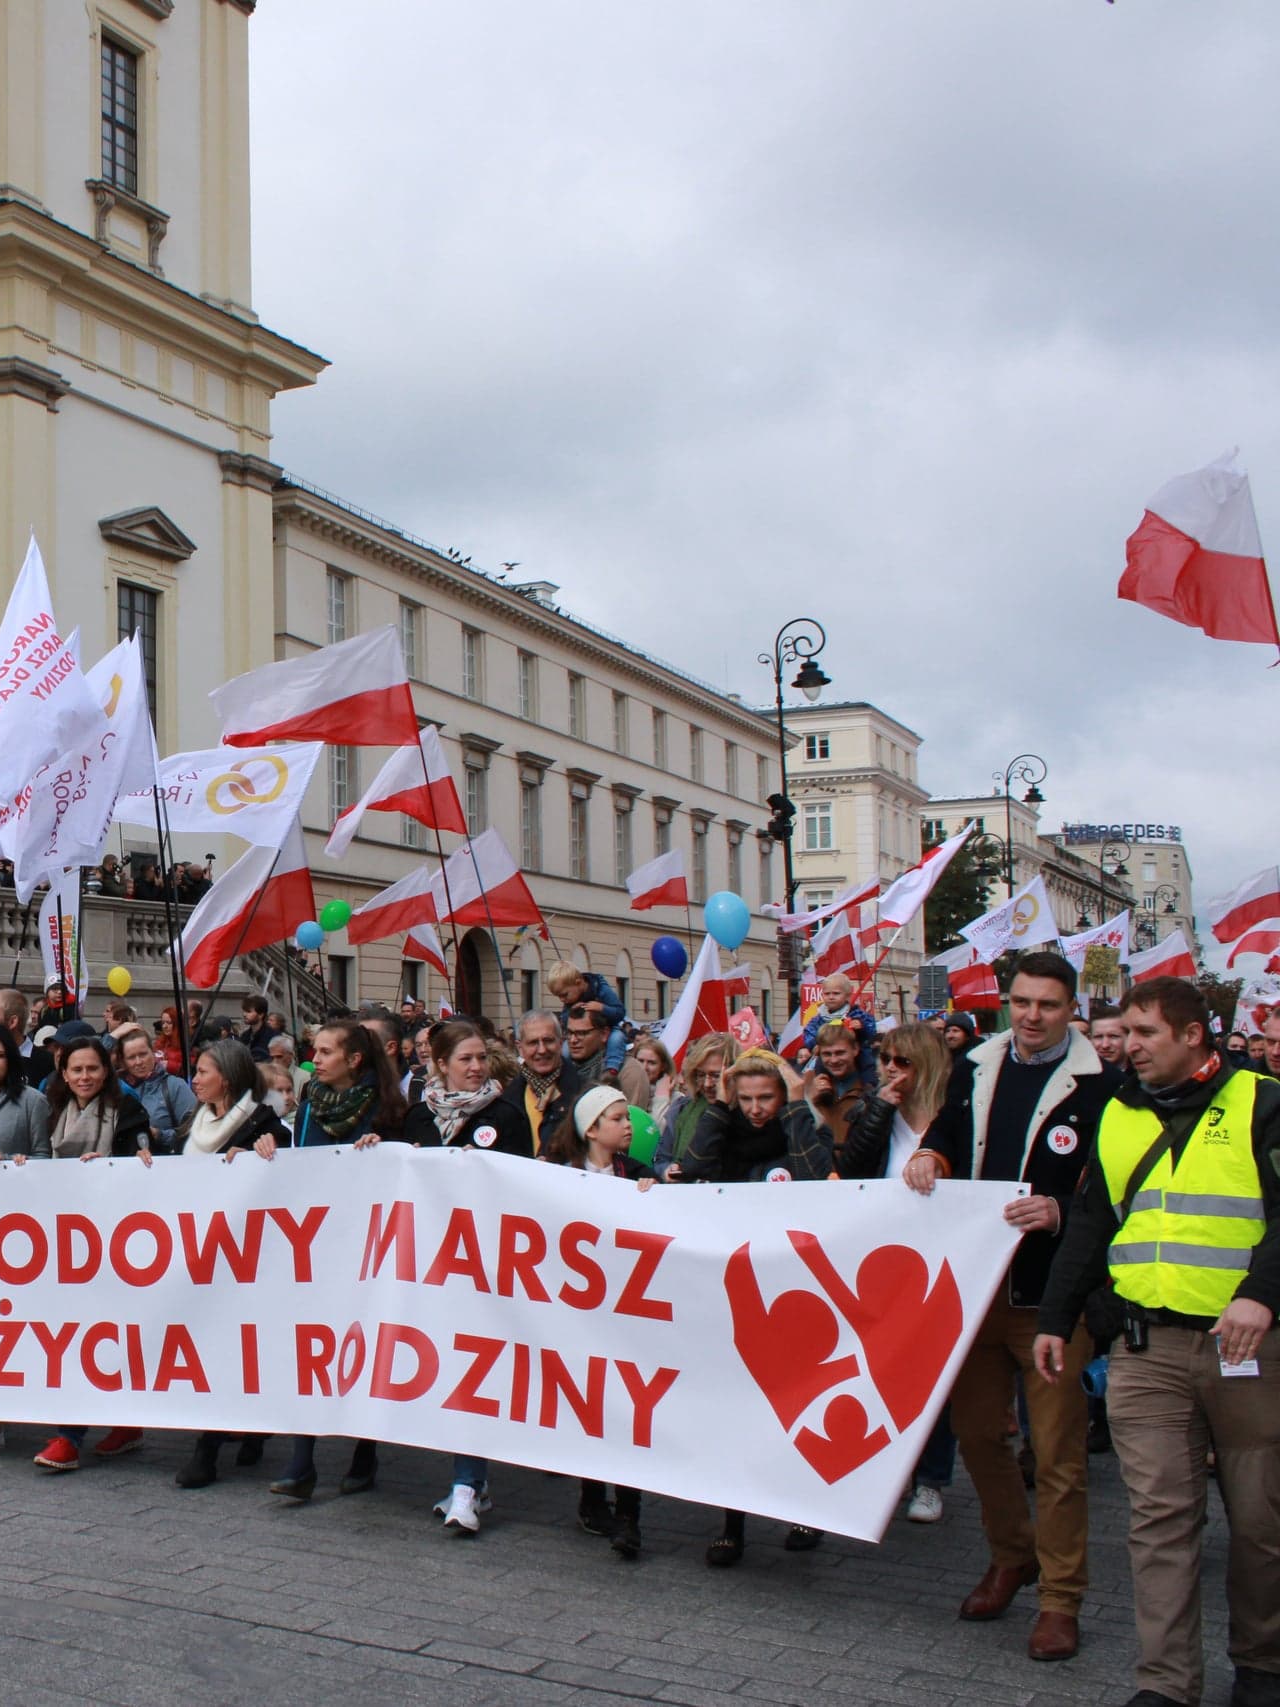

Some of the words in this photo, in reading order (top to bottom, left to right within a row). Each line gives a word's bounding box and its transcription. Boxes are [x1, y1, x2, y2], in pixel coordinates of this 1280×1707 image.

[361, 1201, 674, 1321] MARSZ
[241, 1323, 259, 1394] I
[296, 1322, 680, 1447] RODZINY
